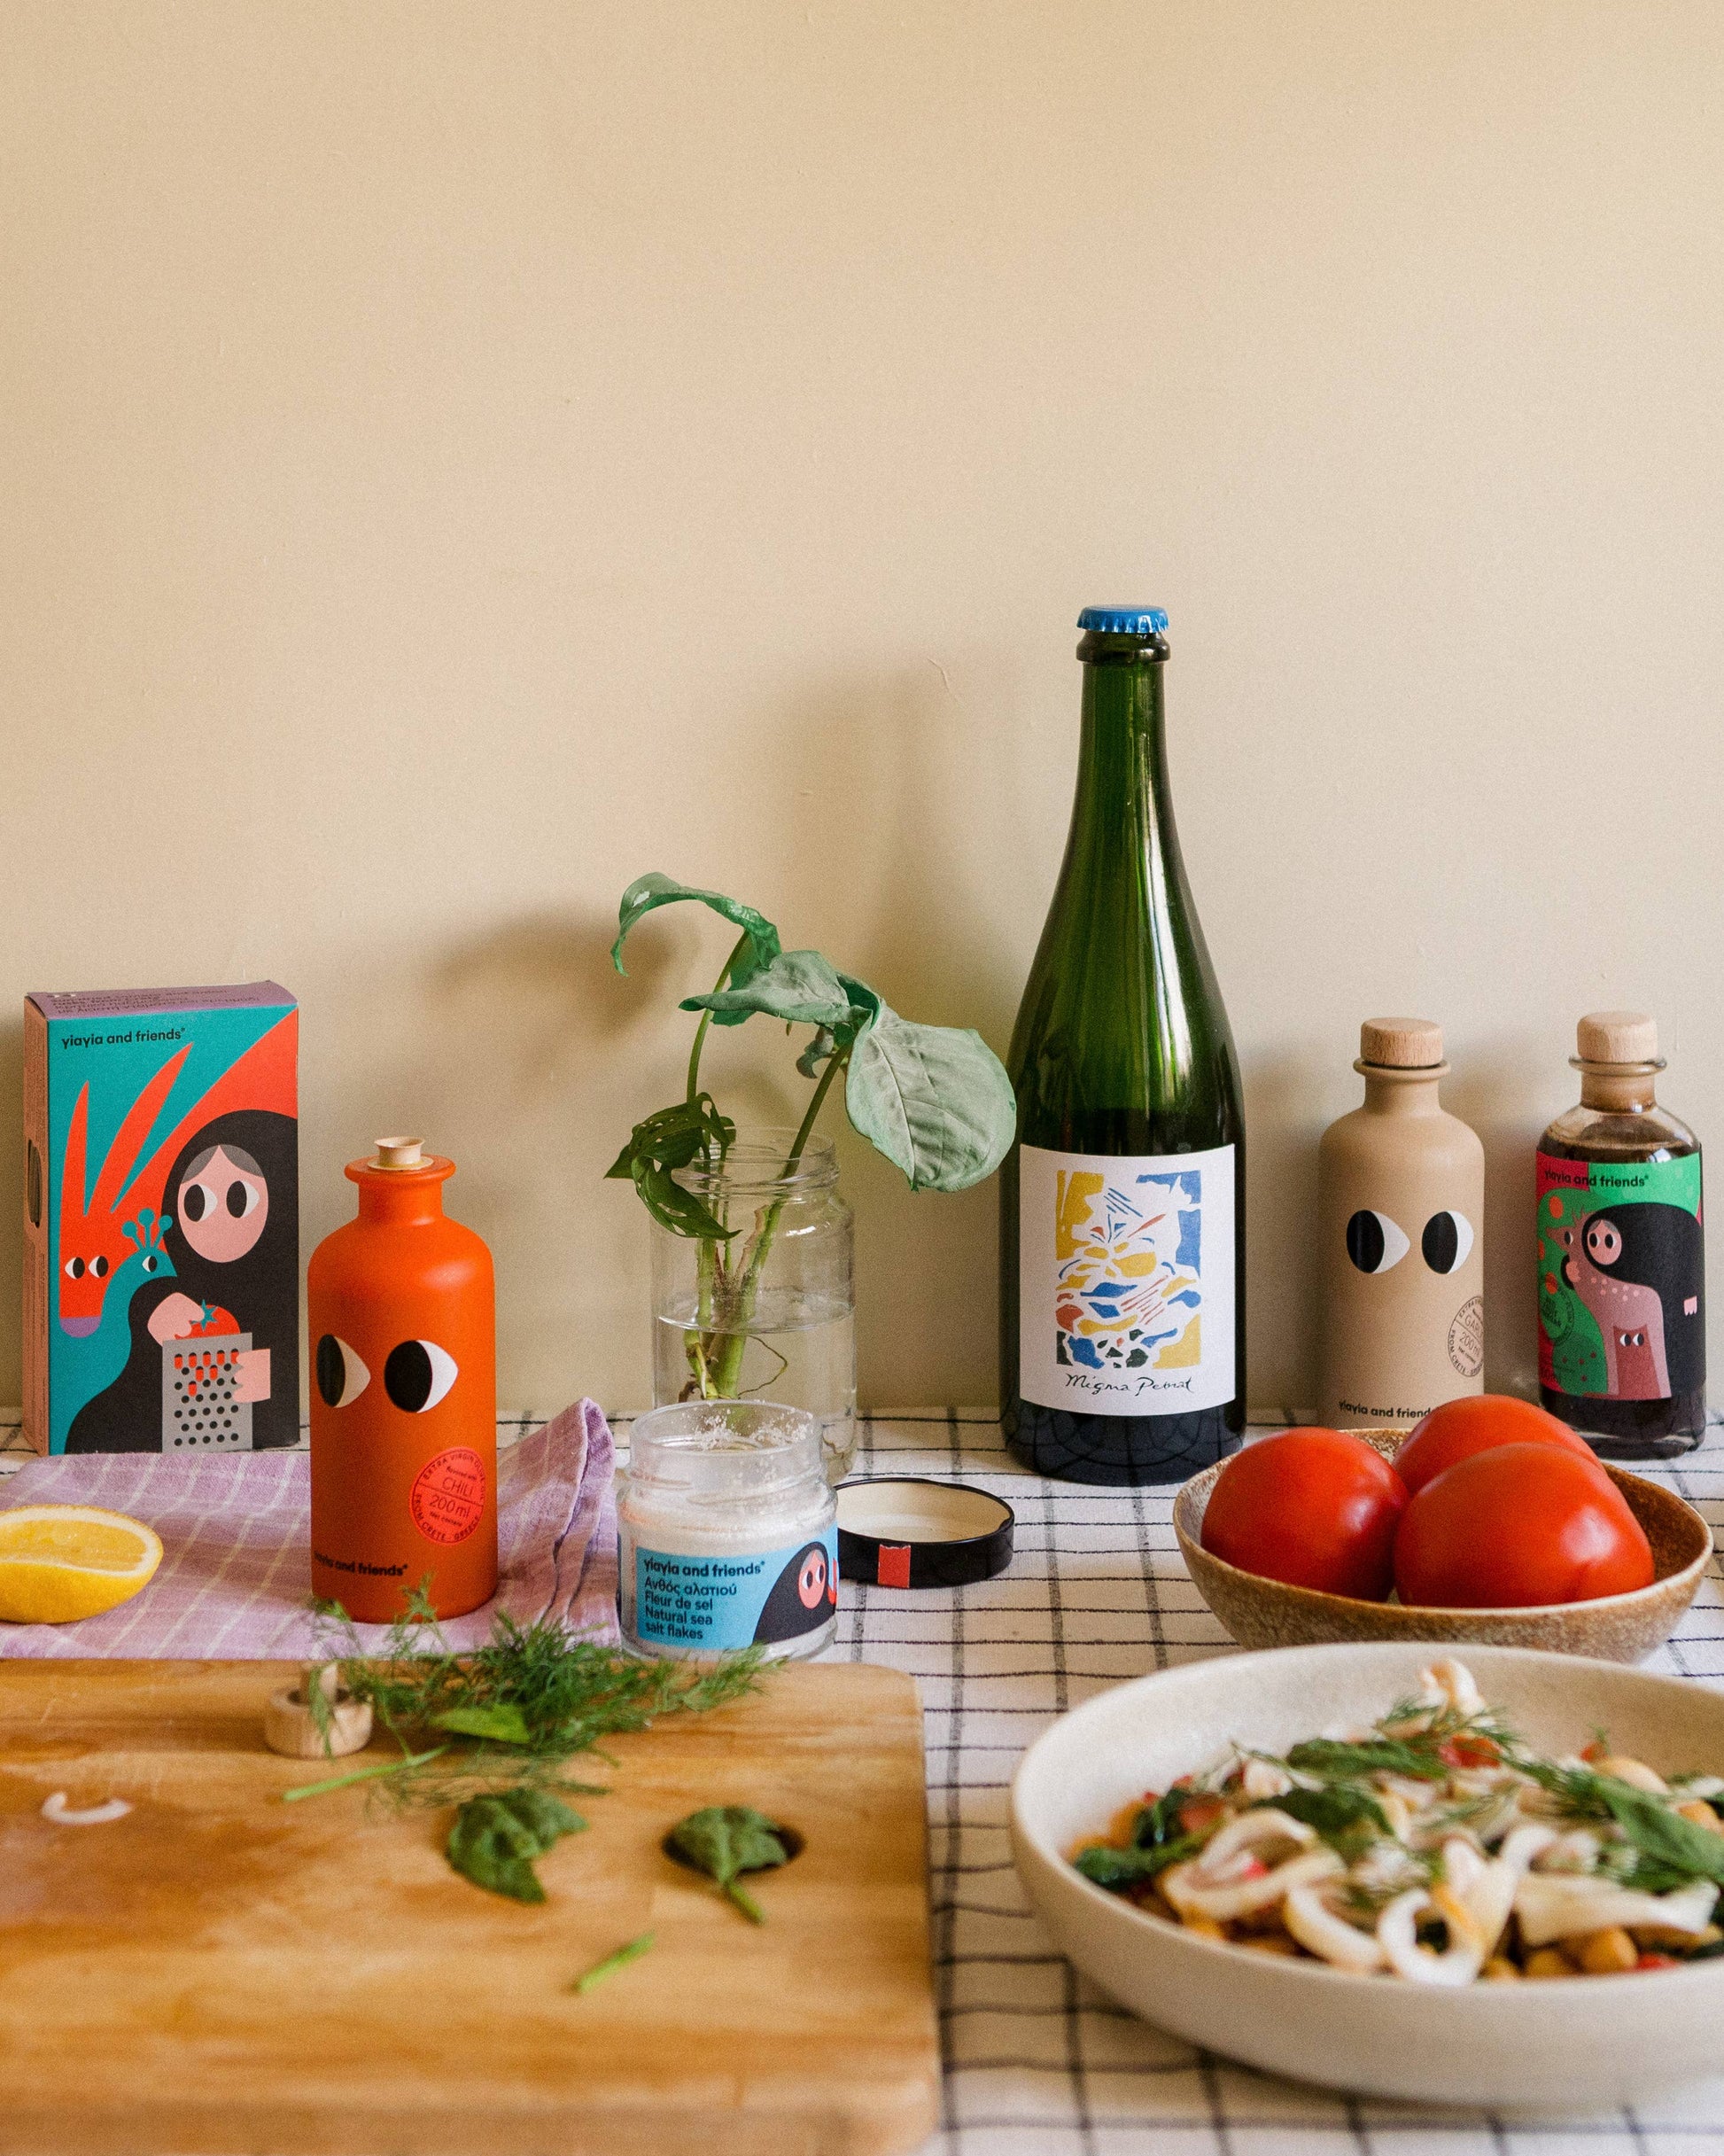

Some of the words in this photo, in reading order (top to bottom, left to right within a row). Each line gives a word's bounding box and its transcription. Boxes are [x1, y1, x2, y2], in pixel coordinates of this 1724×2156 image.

[61, 1033, 104, 1049] yiayia
[106, 1031, 133, 1044] and
[1573, 1175, 1597, 1187] and
[1370, 1407, 1394, 1418] and
[423, 1458, 447, 1480] EXTRA
[442, 1476, 474, 1498] CHILI
[429, 1494, 456, 1514] 200
[335, 1560, 356, 1574] and
[643, 1557, 680, 1576] yiayia
[681, 1564, 709, 1577] and
[644, 1576, 681, 1596] Ανθός
[683, 1583, 738, 1597] αλατιού
[644, 1591, 672, 1607] Fleur
[675, 1596, 692, 1610] de
[695, 1598, 714, 1611] sel
[645, 1605, 687, 1624] Natural
[690, 1615, 713, 1626] sea
[645, 1621, 664, 1636] salt
[667, 1624, 704, 1639] flakes
